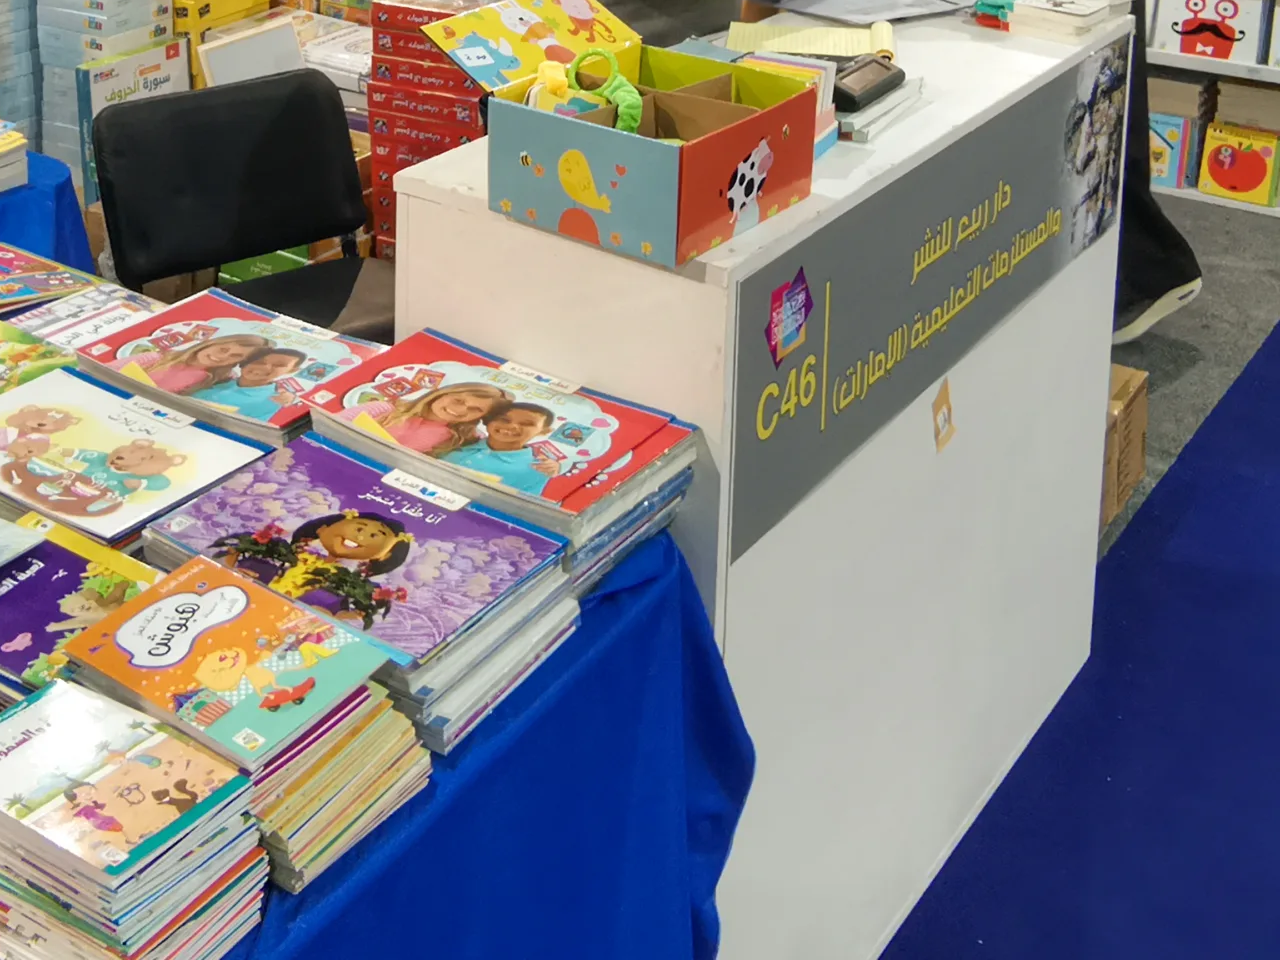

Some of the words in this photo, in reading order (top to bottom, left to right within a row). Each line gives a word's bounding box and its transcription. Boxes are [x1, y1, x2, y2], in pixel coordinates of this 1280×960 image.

[104, 79, 140, 102] الحروف
[142, 73, 171, 92] سبورة
[954, 202, 990, 253] ربيع
[991, 178, 1012, 223] دار
[910, 217, 952, 285] للنشر
[981, 207, 1062, 291] والمستلزمات
[910, 265, 981, 351] التعليمية
[756, 354, 817, 440] C46
